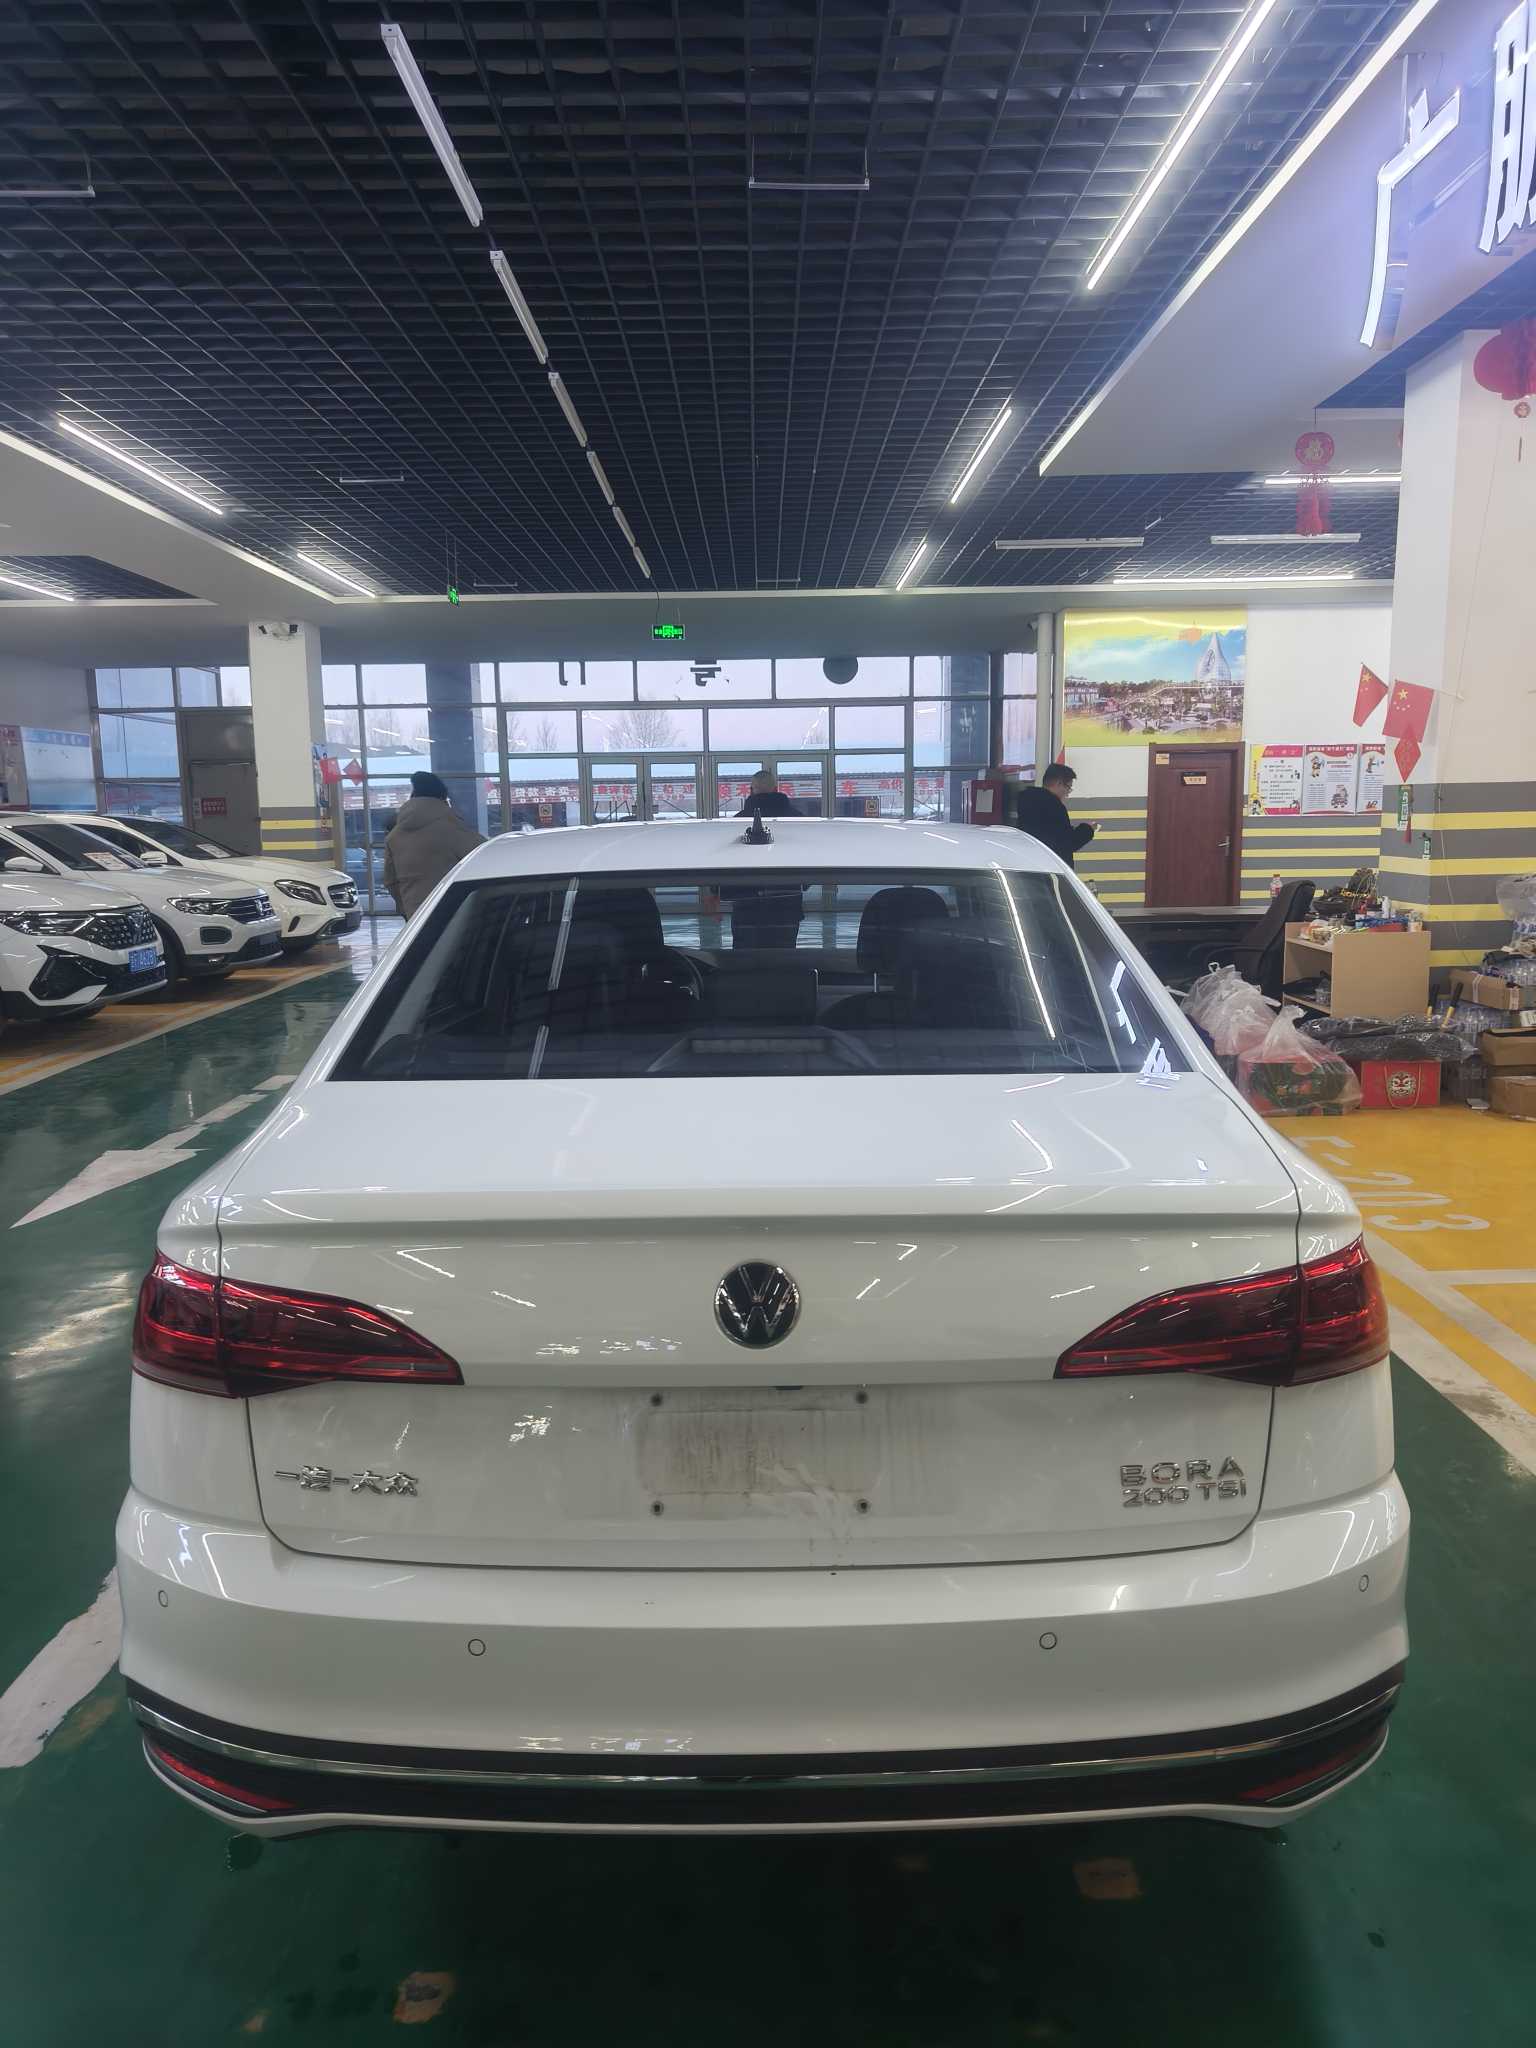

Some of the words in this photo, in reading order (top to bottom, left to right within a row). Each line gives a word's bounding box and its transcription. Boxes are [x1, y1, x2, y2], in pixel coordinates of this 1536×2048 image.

[1119, 1456, 1245, 1488] BORA
[1122, 1485, 1190, 1508] 200
[1195, 1478, 1248, 1501] TSI
